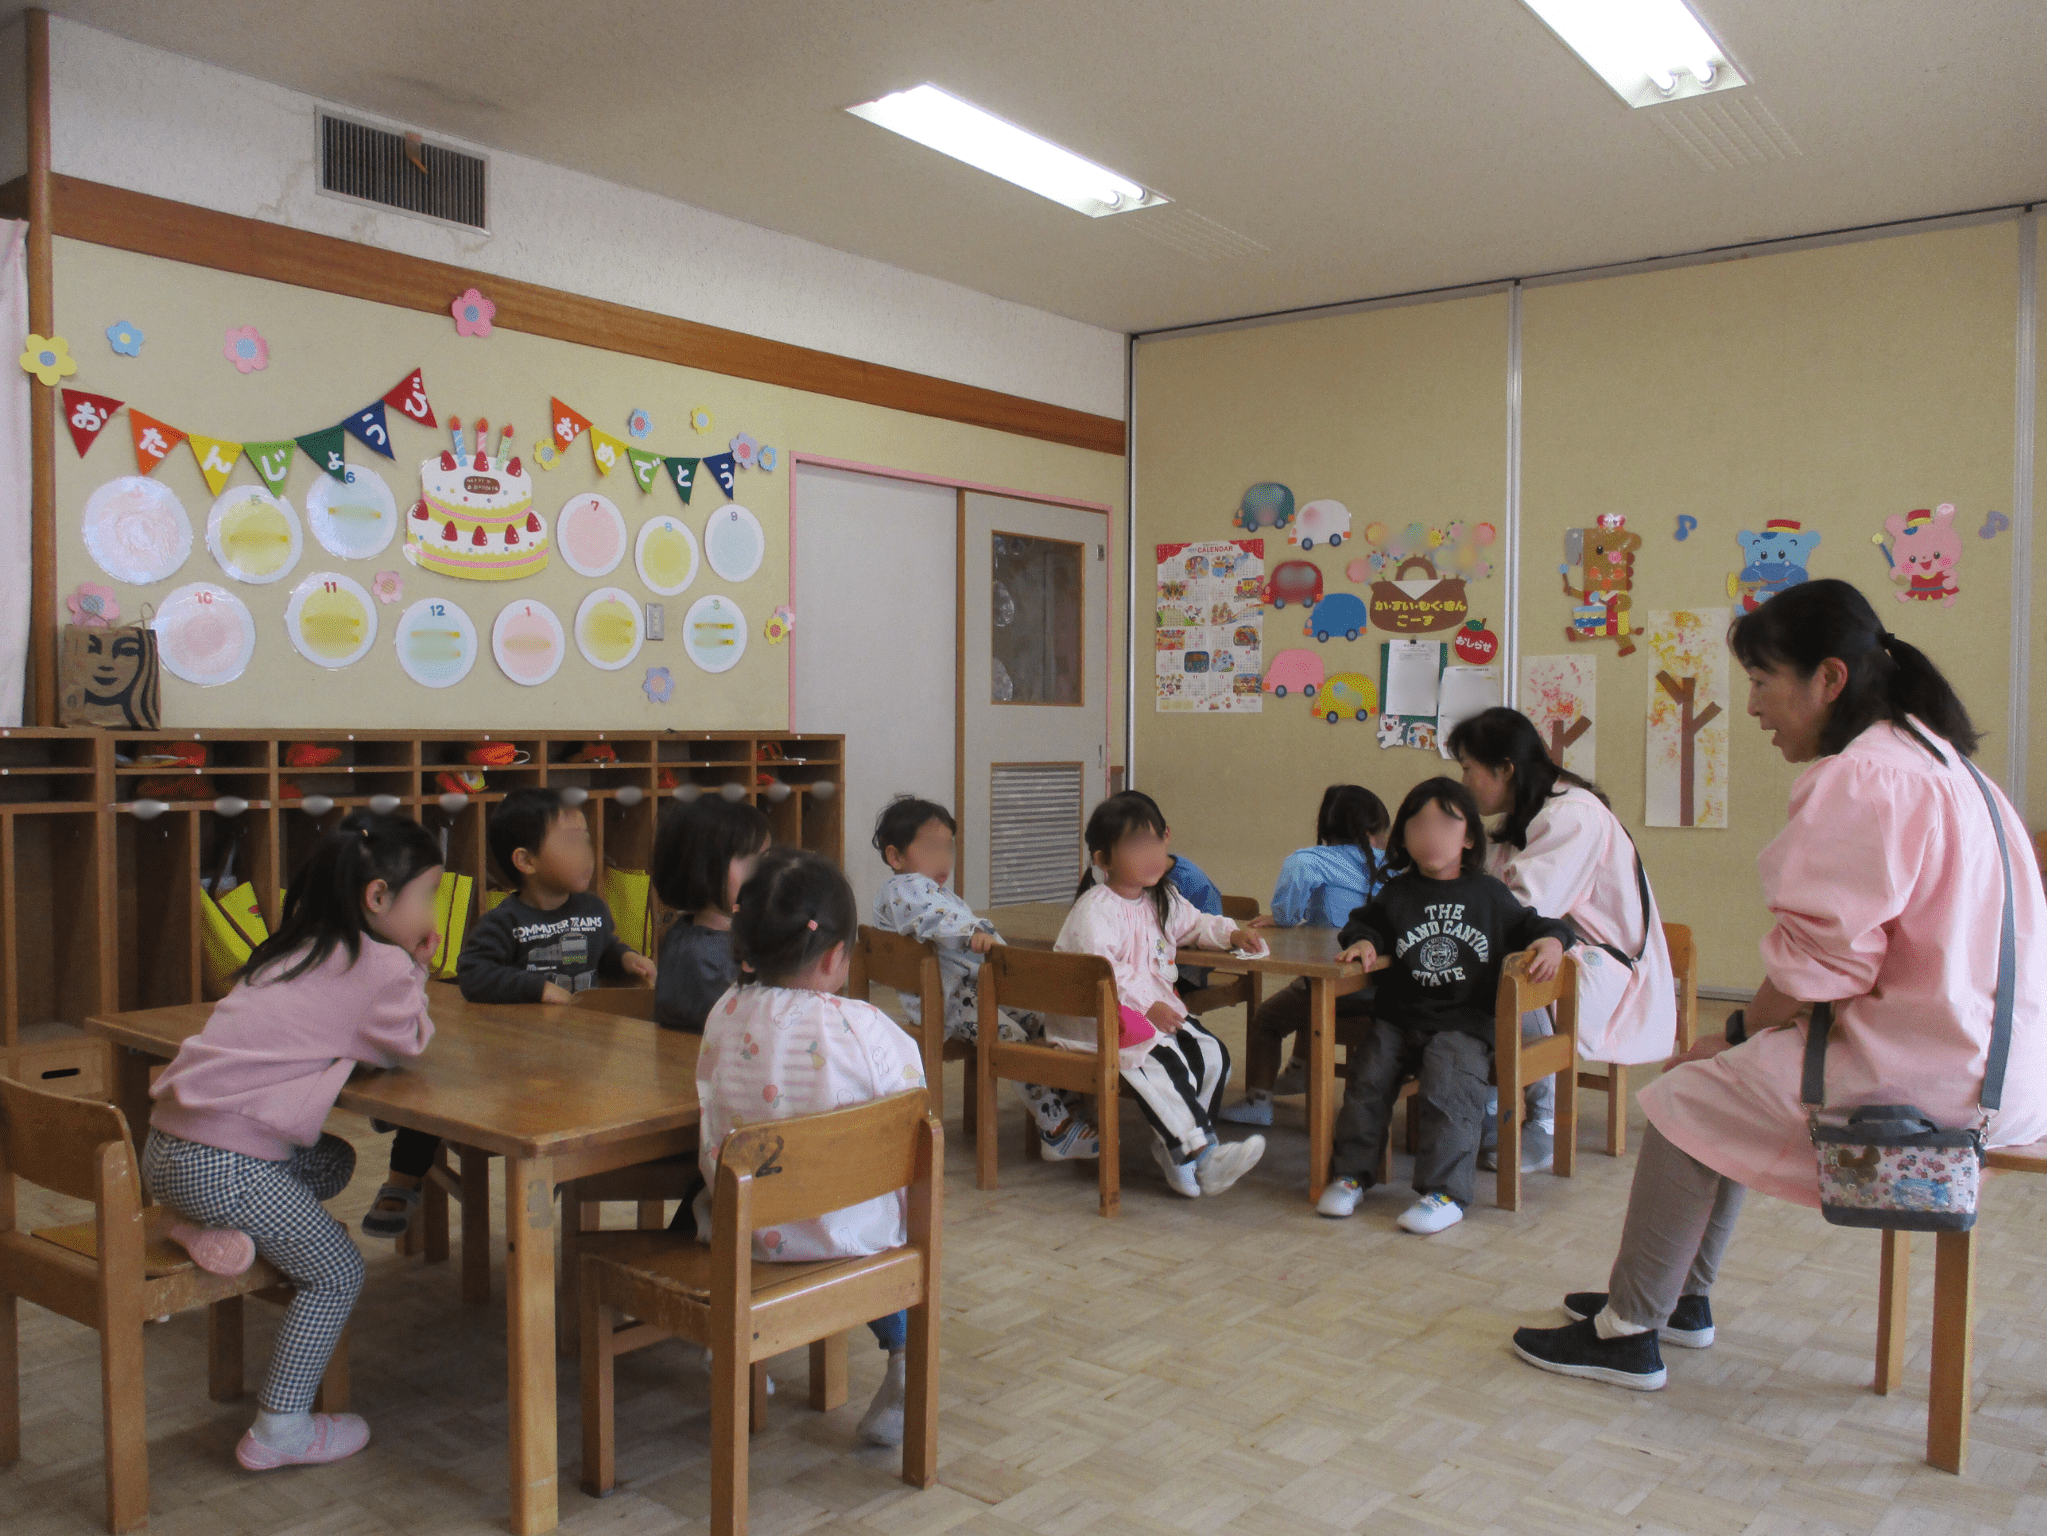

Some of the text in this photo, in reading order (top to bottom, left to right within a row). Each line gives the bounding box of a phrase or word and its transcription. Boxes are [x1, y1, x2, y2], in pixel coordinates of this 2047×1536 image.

[344, 471, 356, 484] 6
[590, 500, 600, 512] 7
[730, 510, 738, 522] 9
[664, 521, 674, 533] 8
[323, 582, 337, 594] 11
[194, 591, 213, 605] 10
[430, 605, 446, 617] 12
[525, 606, 531, 617] 1
[1455, 635, 1492, 653] おしらせ
[1424, 903, 1466, 921] THE
[512, 920, 569, 938] COMMUTER
[570, 917, 602, 927] TRAINS
[755, 1134, 785, 1178] 2
